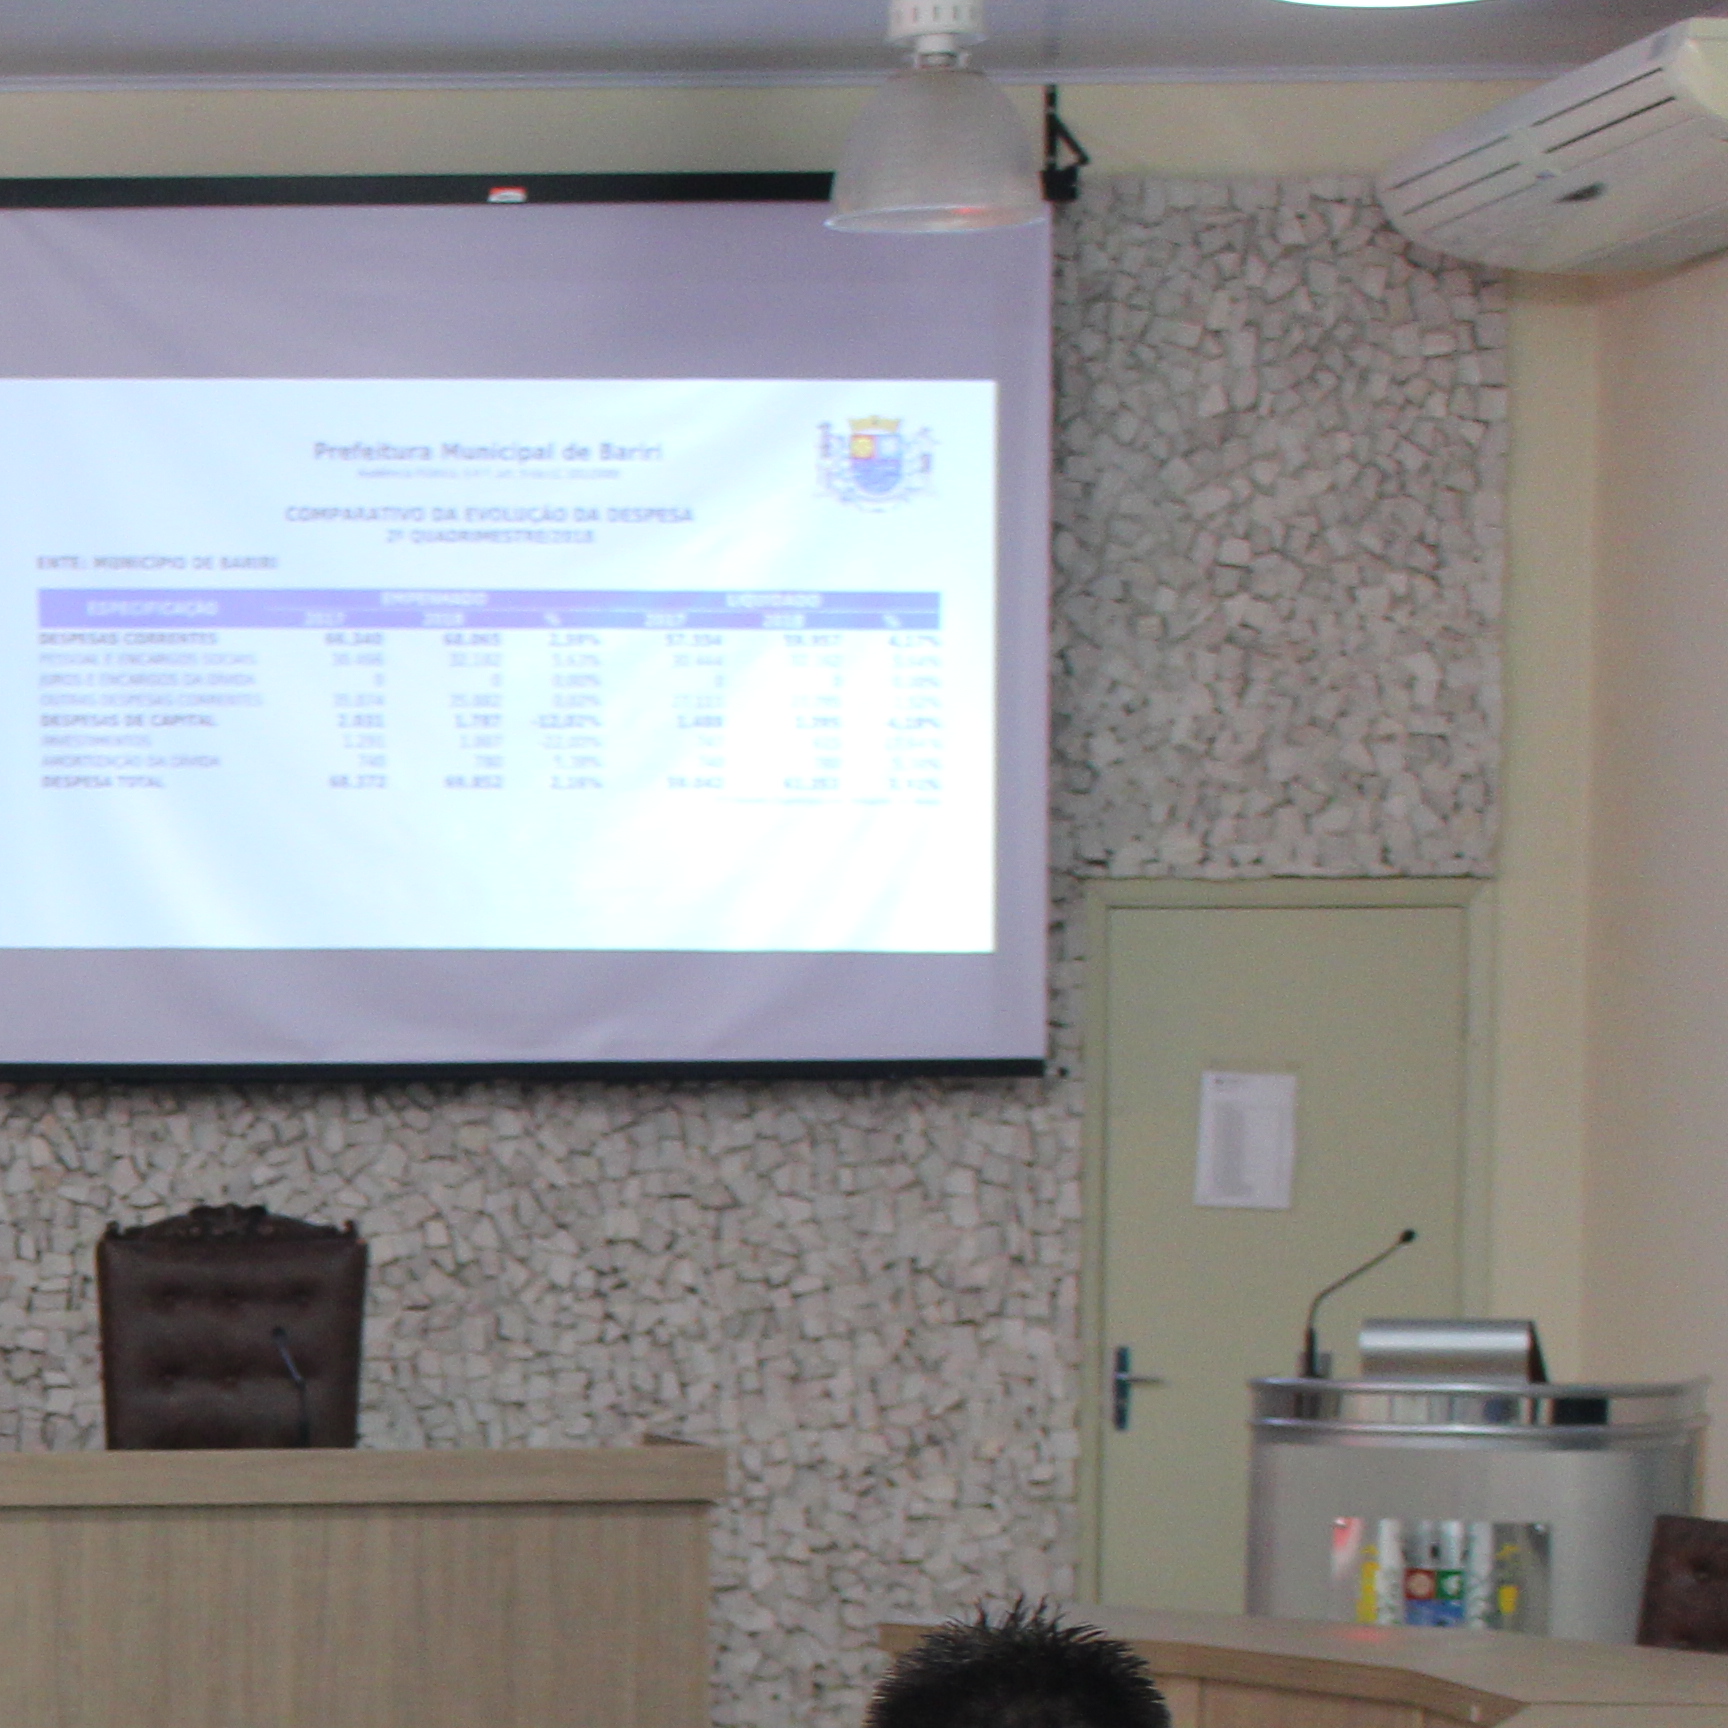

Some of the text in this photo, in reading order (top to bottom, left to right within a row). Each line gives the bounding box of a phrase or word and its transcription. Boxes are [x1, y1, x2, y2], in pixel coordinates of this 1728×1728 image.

[314, 442, 663, 464] Prefeitura Municipal de Bariri
[285, 502, 695, 526] COMPARATIVO DA EVOLUÇÃO DA DESPESA
